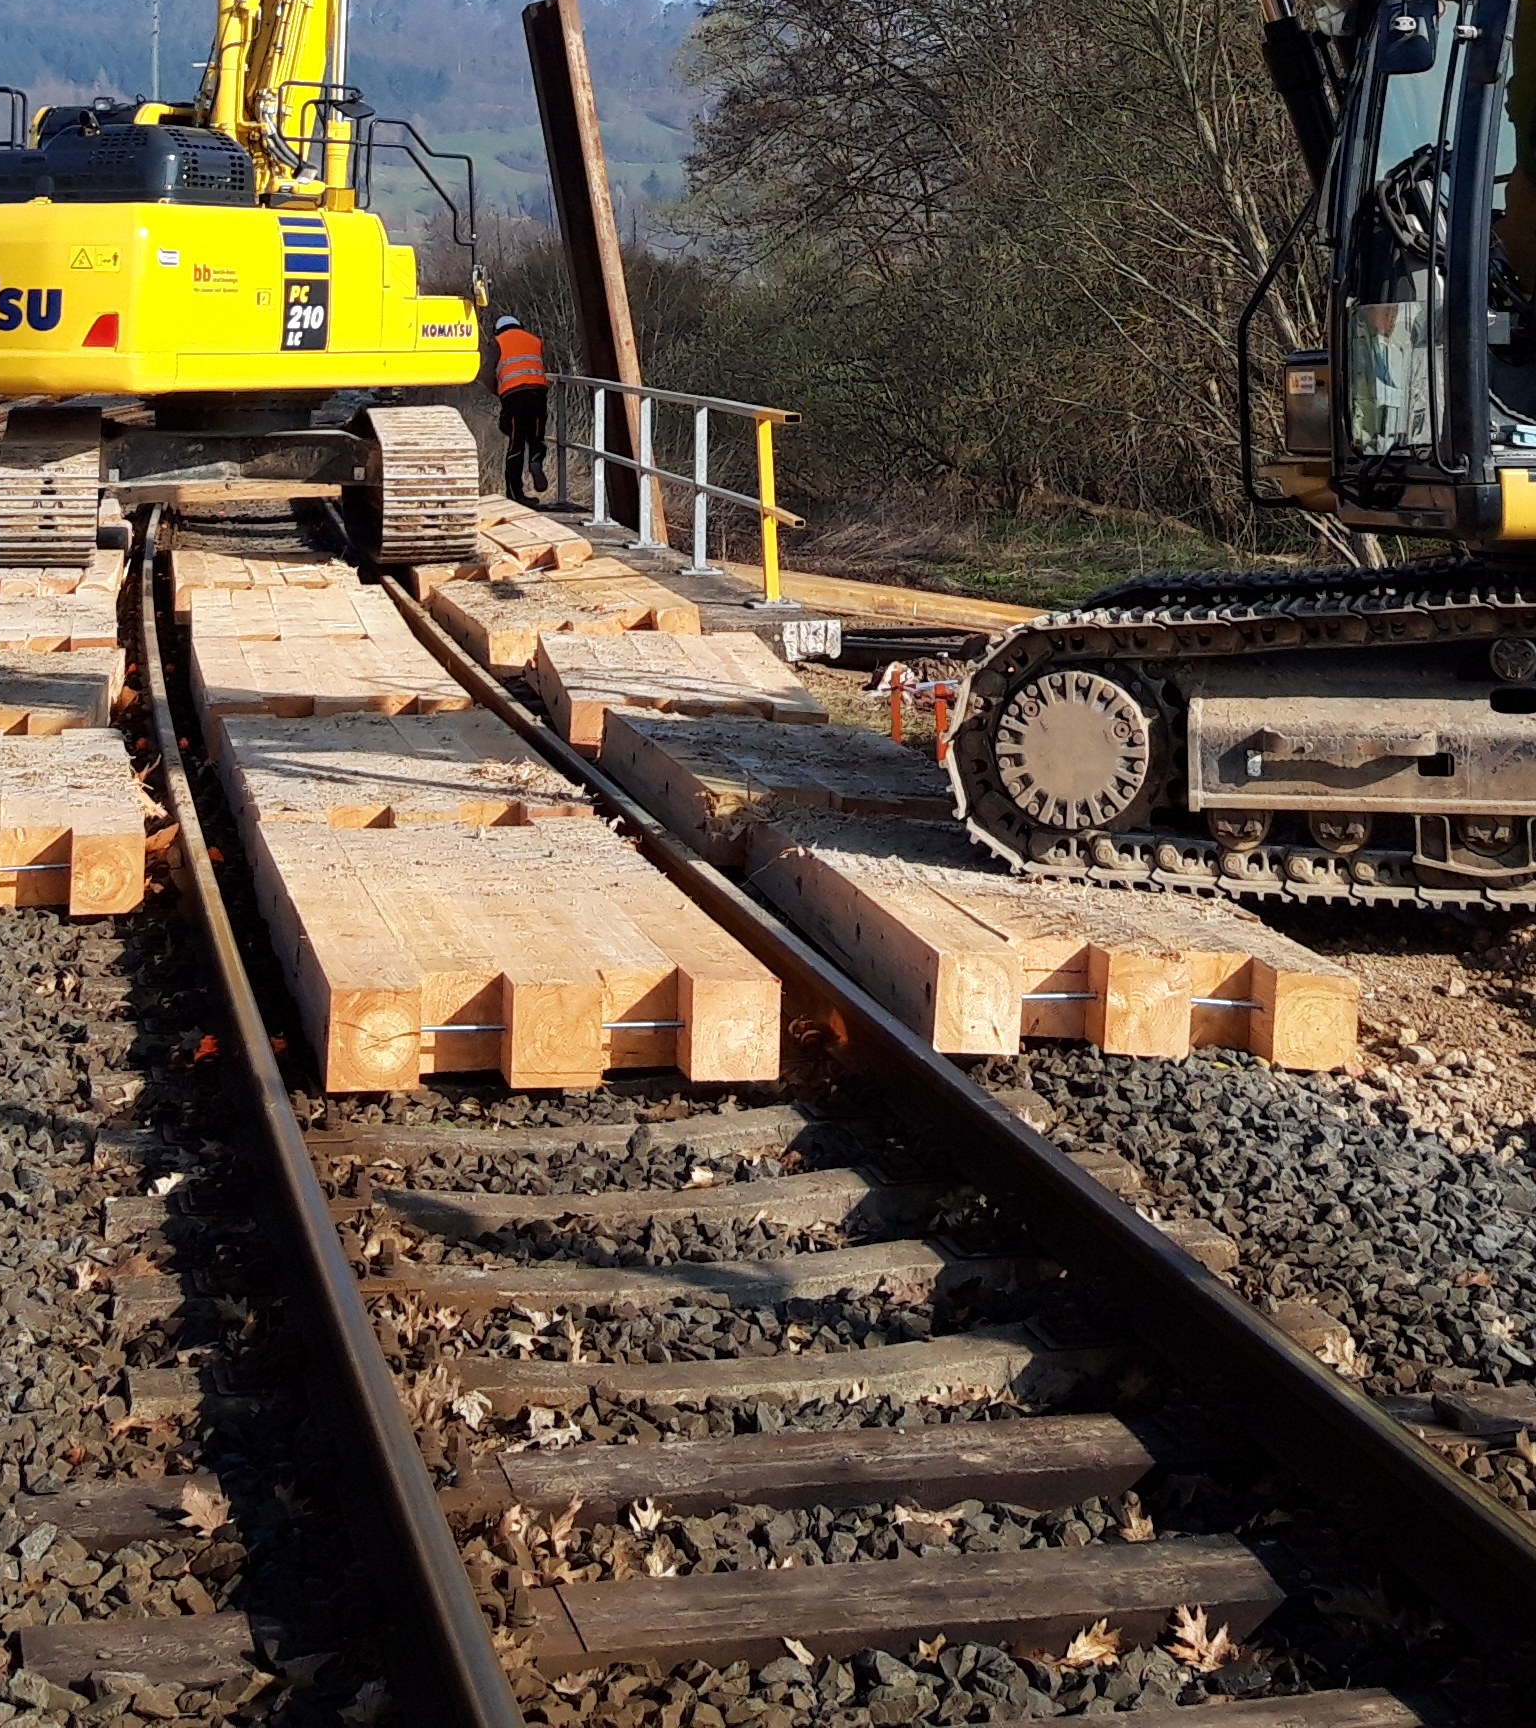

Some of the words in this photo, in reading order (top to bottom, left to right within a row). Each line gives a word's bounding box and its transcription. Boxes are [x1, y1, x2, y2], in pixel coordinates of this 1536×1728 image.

[193, 263, 212, 283] bb
[289, 285, 310, 304] PC
[287, 305, 325, 331] 210
[421, 320, 473, 338] KOMATSU
[286, 331, 303, 347] LC
